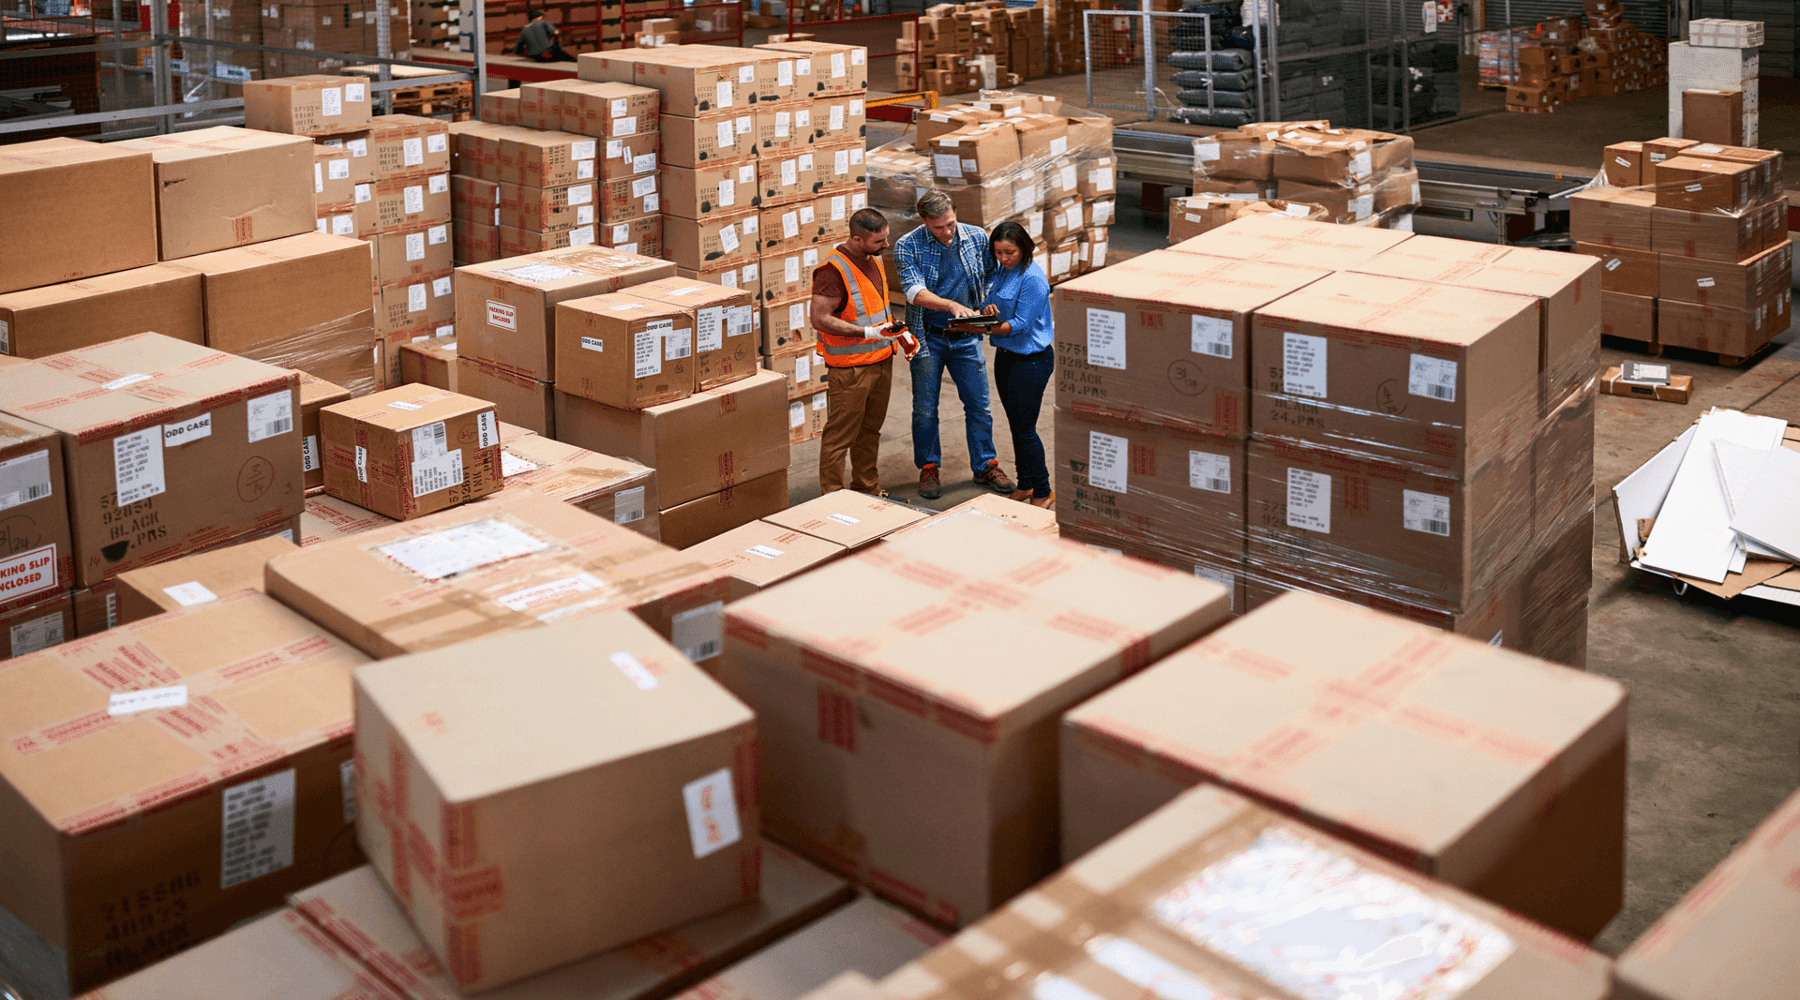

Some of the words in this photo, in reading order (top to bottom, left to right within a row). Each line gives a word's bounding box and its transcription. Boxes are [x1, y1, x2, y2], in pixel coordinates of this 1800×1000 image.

[1063, 370, 1102, 385] BLACK
[165, 426, 185, 439] ODD
[187, 418, 210, 432] CASE
[110, 511, 159, 540] BLACK
[0, 563, 26, 579] KING
[29, 556, 50, 570] SLIP
[0, 572, 42, 591] NCLOSED
